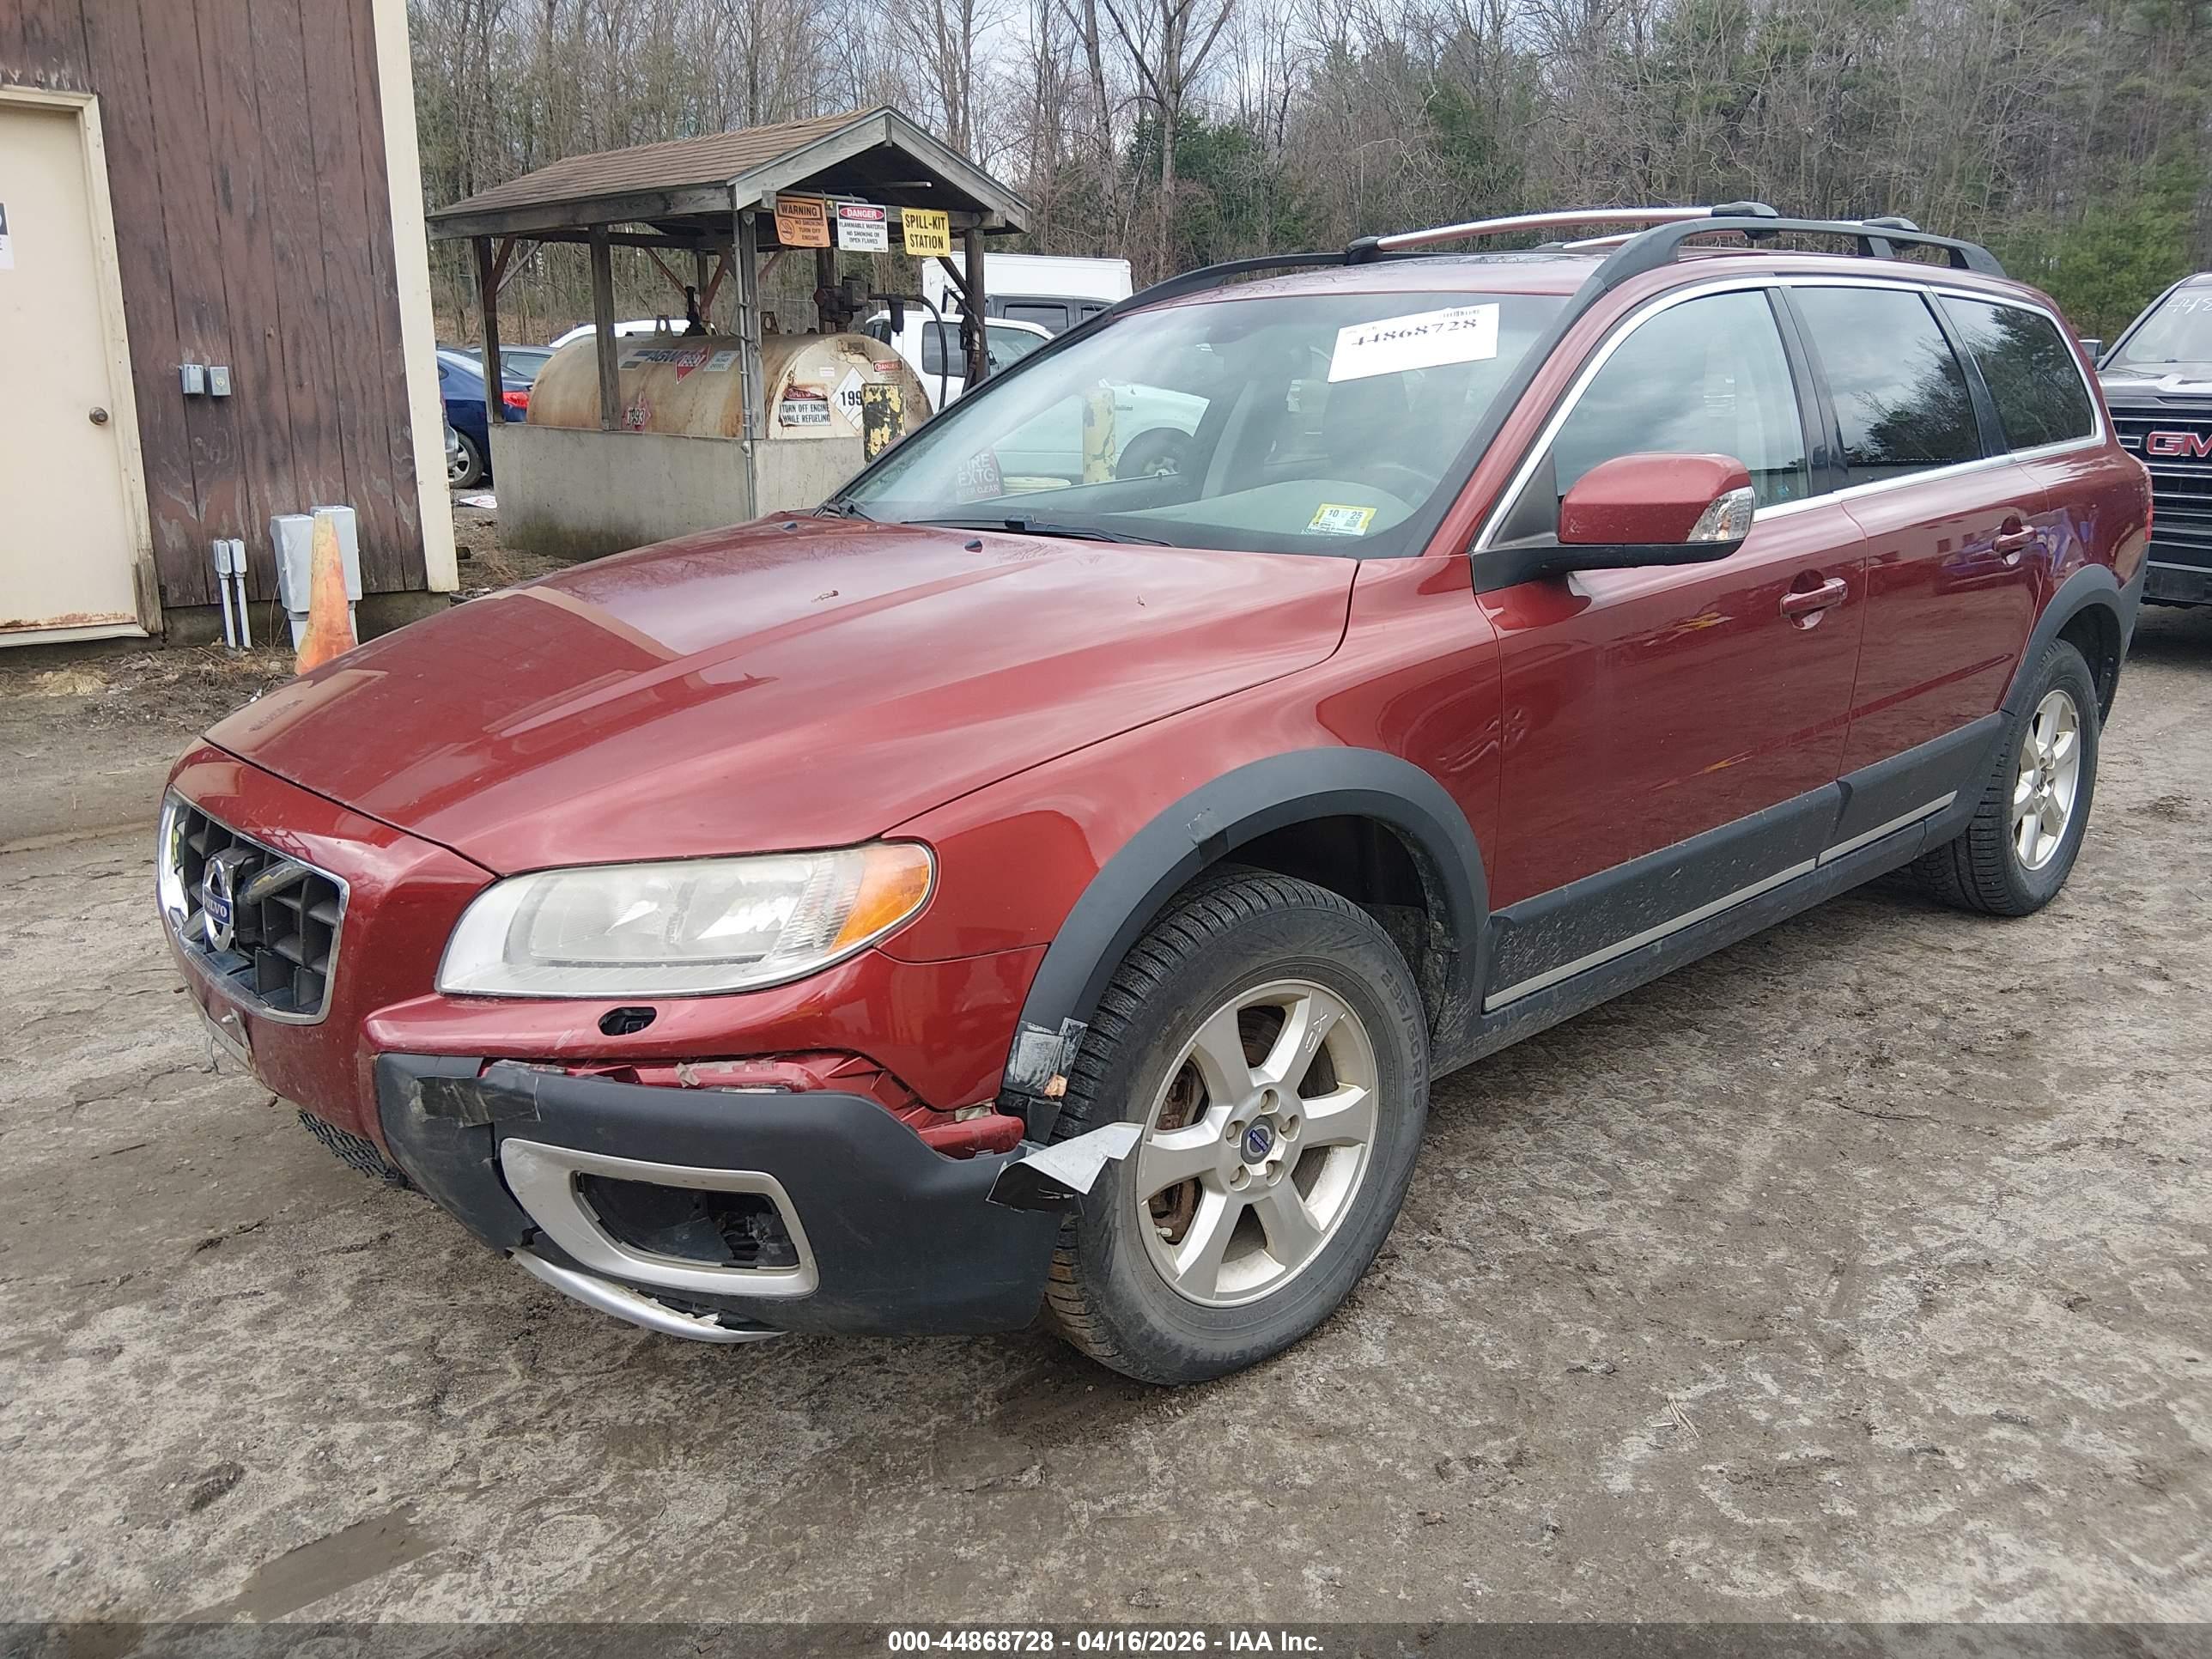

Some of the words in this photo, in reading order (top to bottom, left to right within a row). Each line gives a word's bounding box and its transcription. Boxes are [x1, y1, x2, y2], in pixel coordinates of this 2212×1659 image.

[781, 204, 817, 216] WARNING
[847, 207, 877, 219] DANGER
[905, 214, 945, 230] SPILL-KIT
[909, 233, 945, 250] STATION
[1352, 318, 1478, 346] 44868728
[841, 390, 862, 406] 199
[782, 404, 797, 413] TURN
[798, 404, 808, 413] OFF
[810, 404, 829, 413] ENGINE
[782, 414, 799, 422] WHILE
[801, 414, 831, 422] REFUELING
[1328, 509, 1340, 518] 10
[1349, 511, 1364, 520] 25
